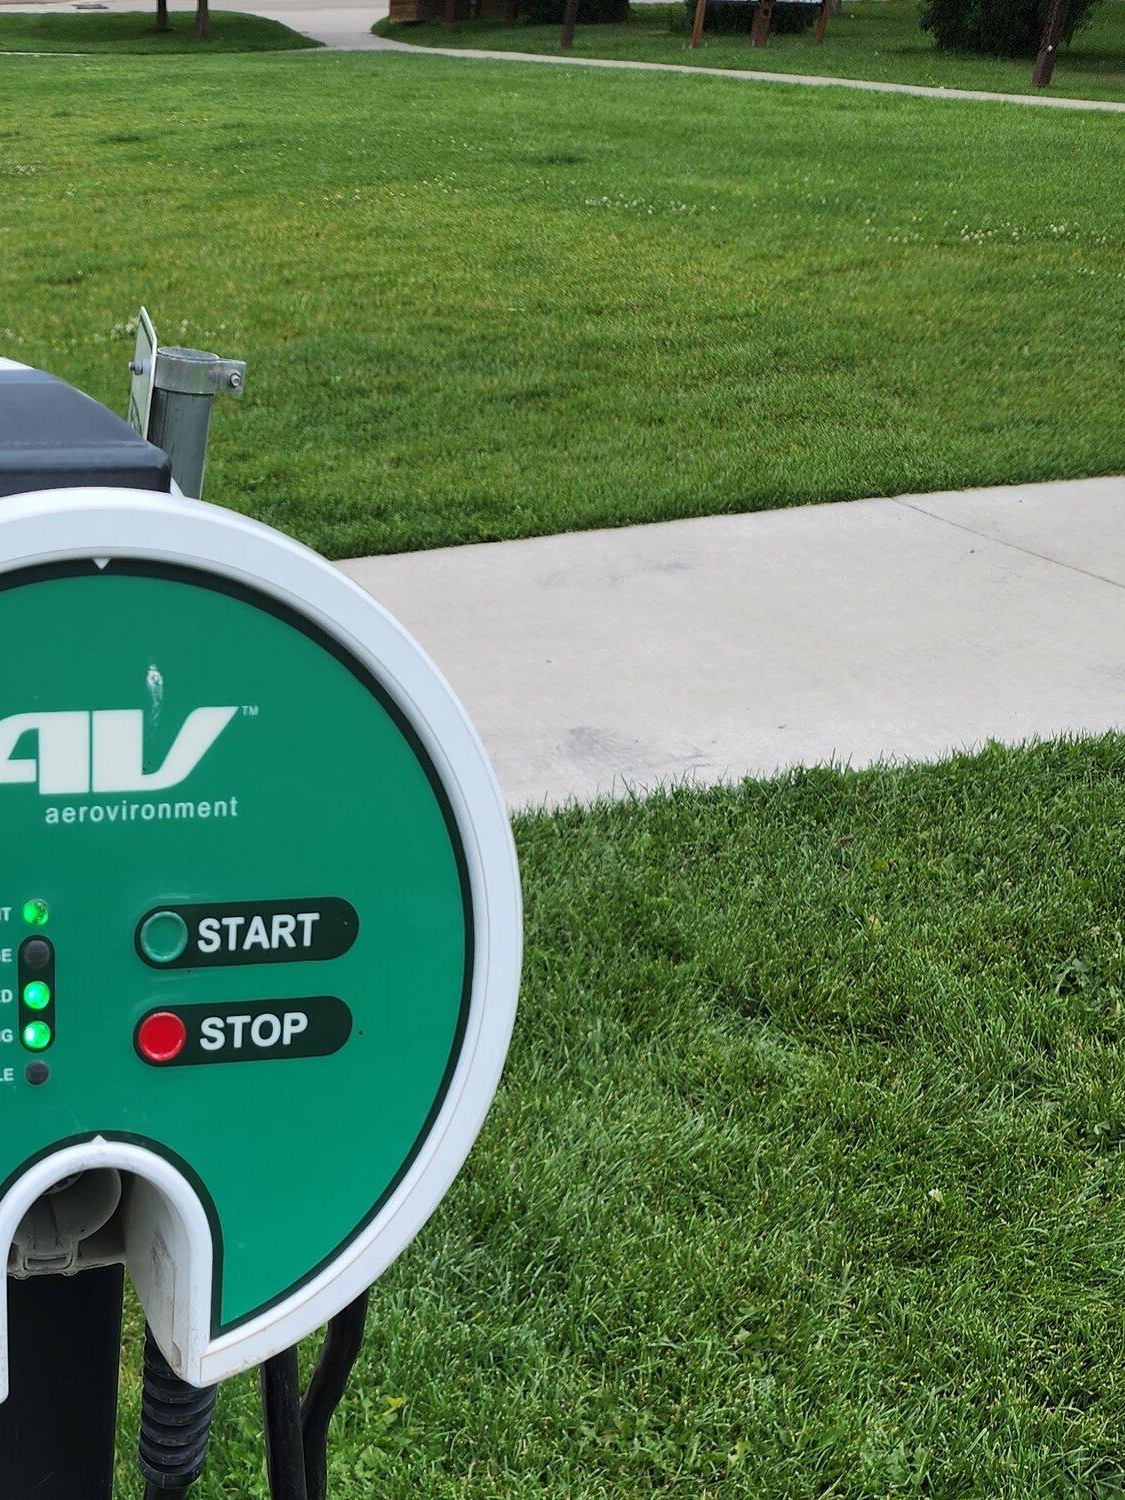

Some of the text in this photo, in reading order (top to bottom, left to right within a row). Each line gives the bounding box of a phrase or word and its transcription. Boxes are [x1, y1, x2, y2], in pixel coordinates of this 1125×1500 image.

[45, 797, 238, 824] aerovironment
[197, 912, 321, 953] START
[199, 1011, 309, 1051] STOP
